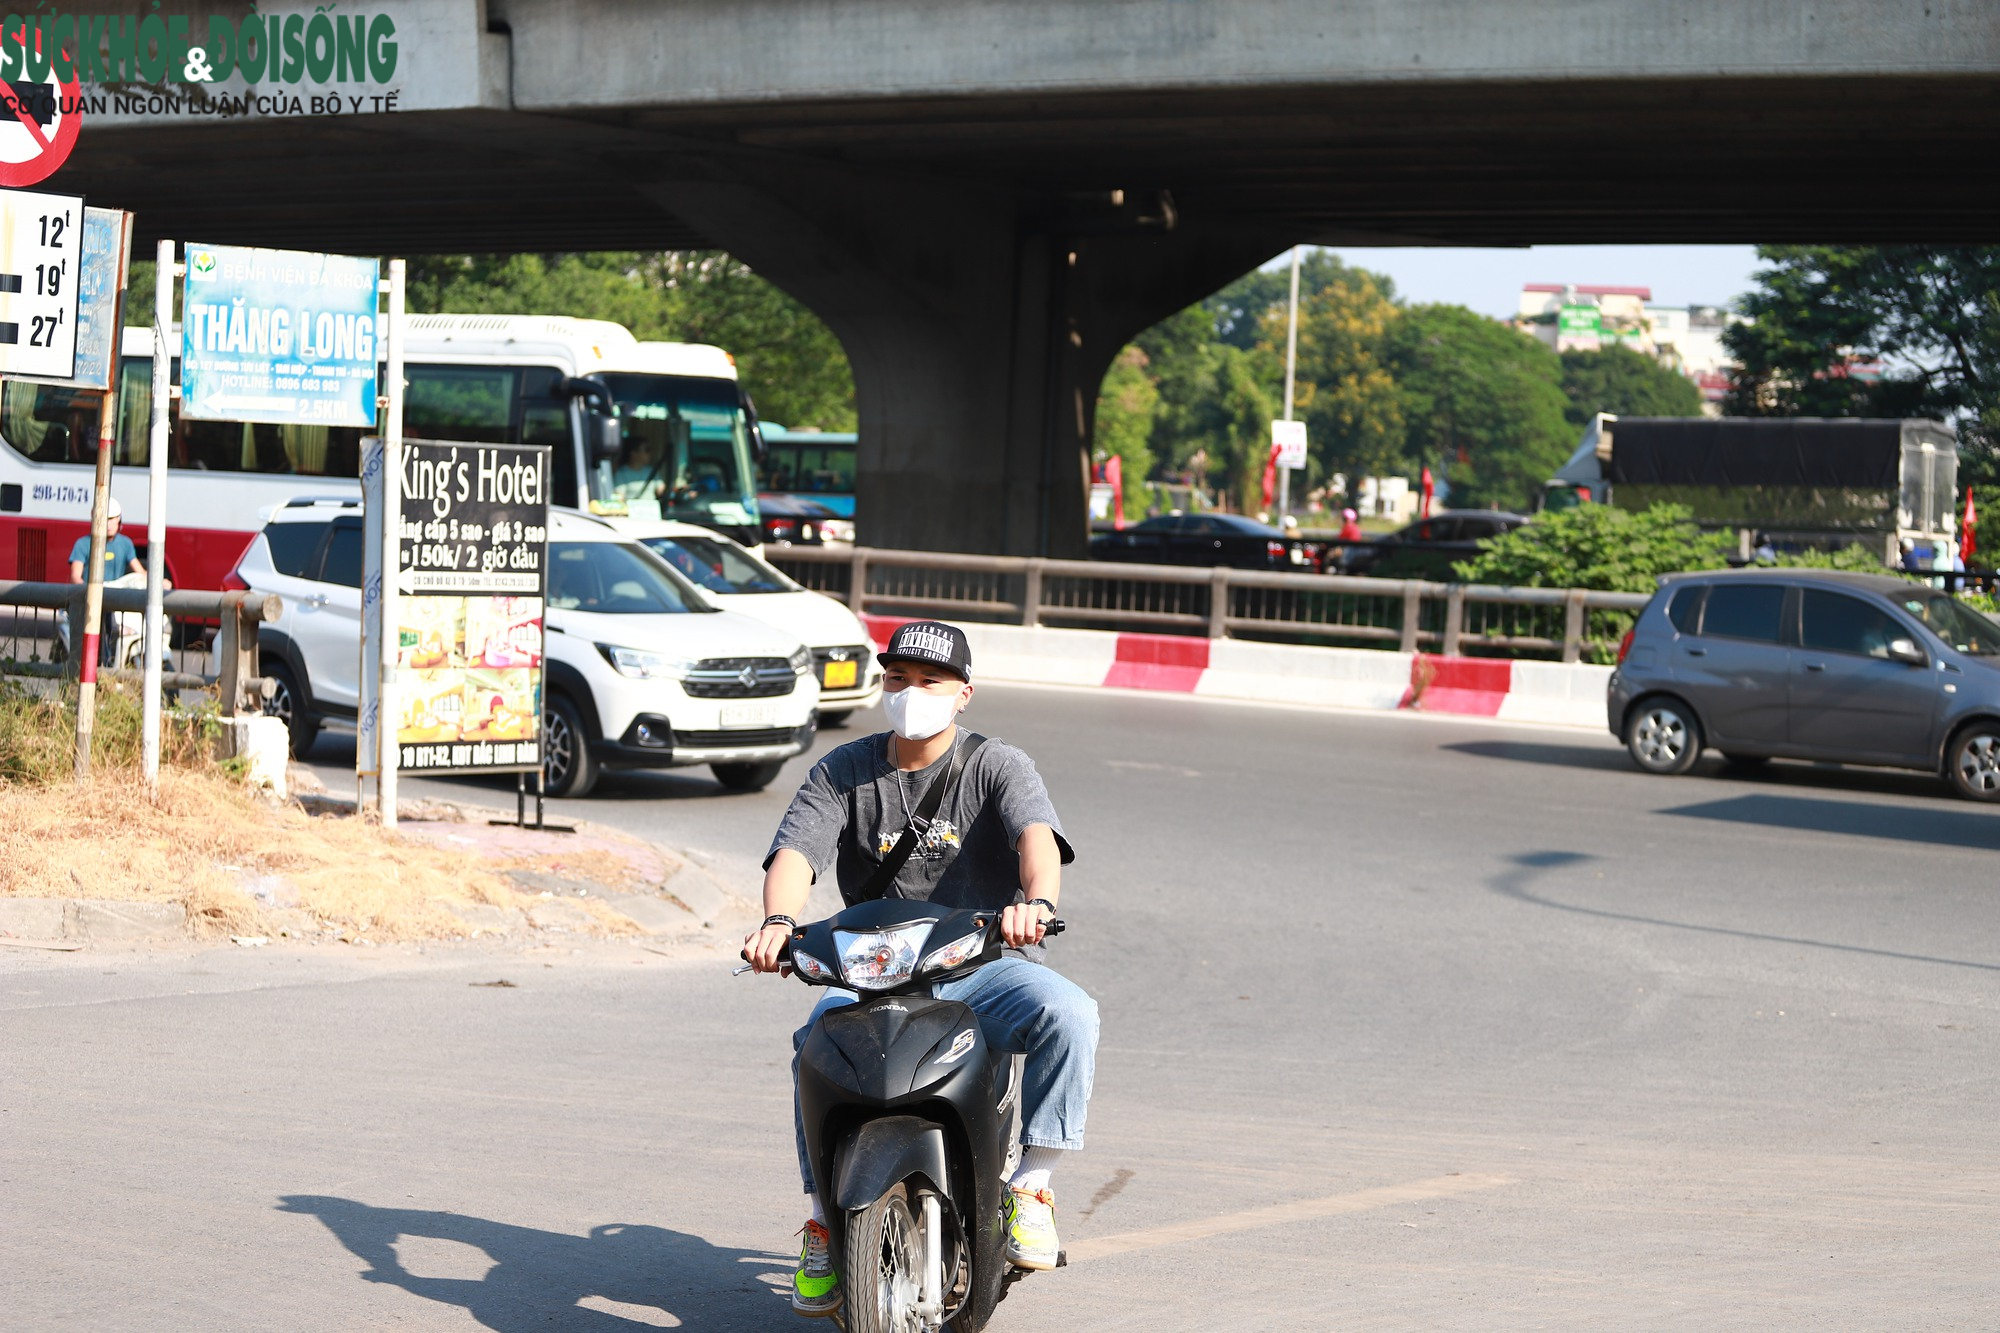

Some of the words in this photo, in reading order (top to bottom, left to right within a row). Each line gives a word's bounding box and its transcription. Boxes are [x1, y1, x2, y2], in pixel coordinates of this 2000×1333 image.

[223, 262, 267, 284] BỆNH
[271, 265, 305, 288] VIỆN
[309, 270, 329, 287] ĐA
[334, 272, 373, 290] KHOA
[190, 297, 290, 355] THĂNG
[300, 311, 374, 361] LONG
[221, 375, 273, 389] HOTLINE:
[299, 400, 349, 420] 2.5KM
[477, 449, 544, 505] Hotel
[400, 514, 423, 543] ẳng
[424, 517, 448, 544] cấp
[450, 518, 459, 541] 5
[461, 523, 483, 541] sao
[491, 521, 511, 545] giá
[513, 521, 522, 542] 3
[524, 525, 545, 543] sao
[411, 544, 462, 570] 150k/
[466, 545, 478, 568] 2
[481, 546, 508, 573] giờ
[509, 542, 539, 570] đầu
[898, 632, 953, 658] ADVISORY
[903, 625, 954, 642] PARENTAL
[896, 647, 922, 656] EXPLICIT
[402, 746, 415, 767] 10
[869, 1003, 909, 1014] HONDA
